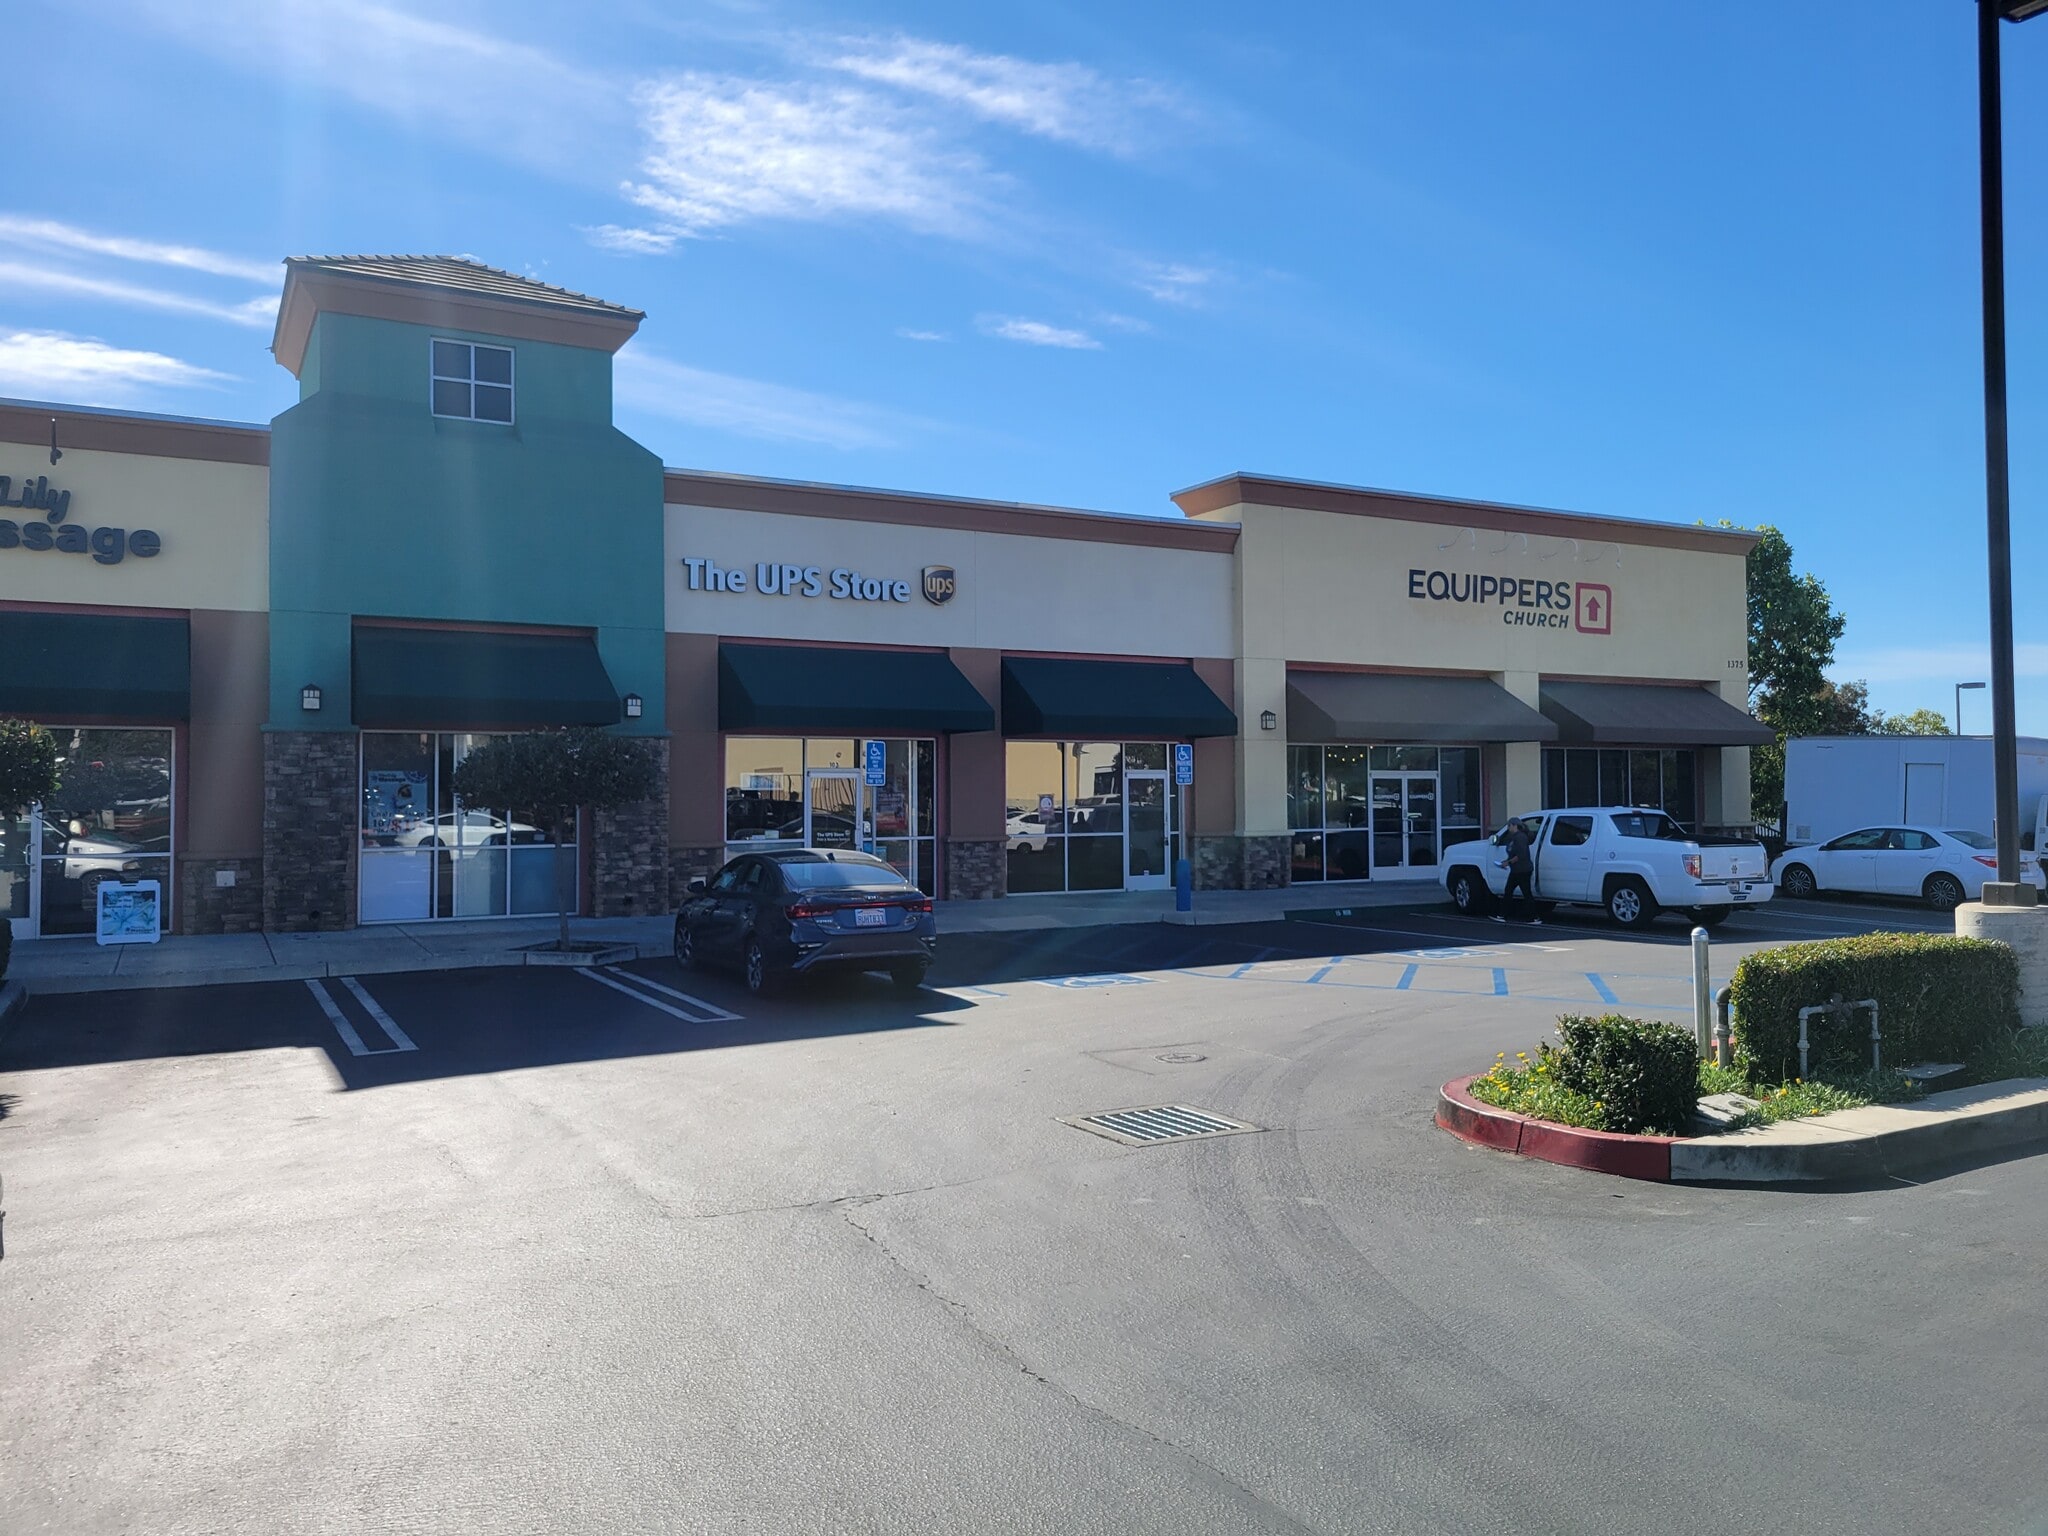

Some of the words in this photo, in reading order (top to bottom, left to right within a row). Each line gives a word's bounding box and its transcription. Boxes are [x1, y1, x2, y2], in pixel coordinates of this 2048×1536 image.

[683, 557, 748, 593] The
[755, 562, 824, 598] UPS
[829, 568, 912, 603] Store
[926, 576, 954, 600] ups
[1408, 568, 1572, 611] EQUIPPERS
[1503, 610, 1570, 629] CHURCH
[1727, 660, 1744, 669] 1375
